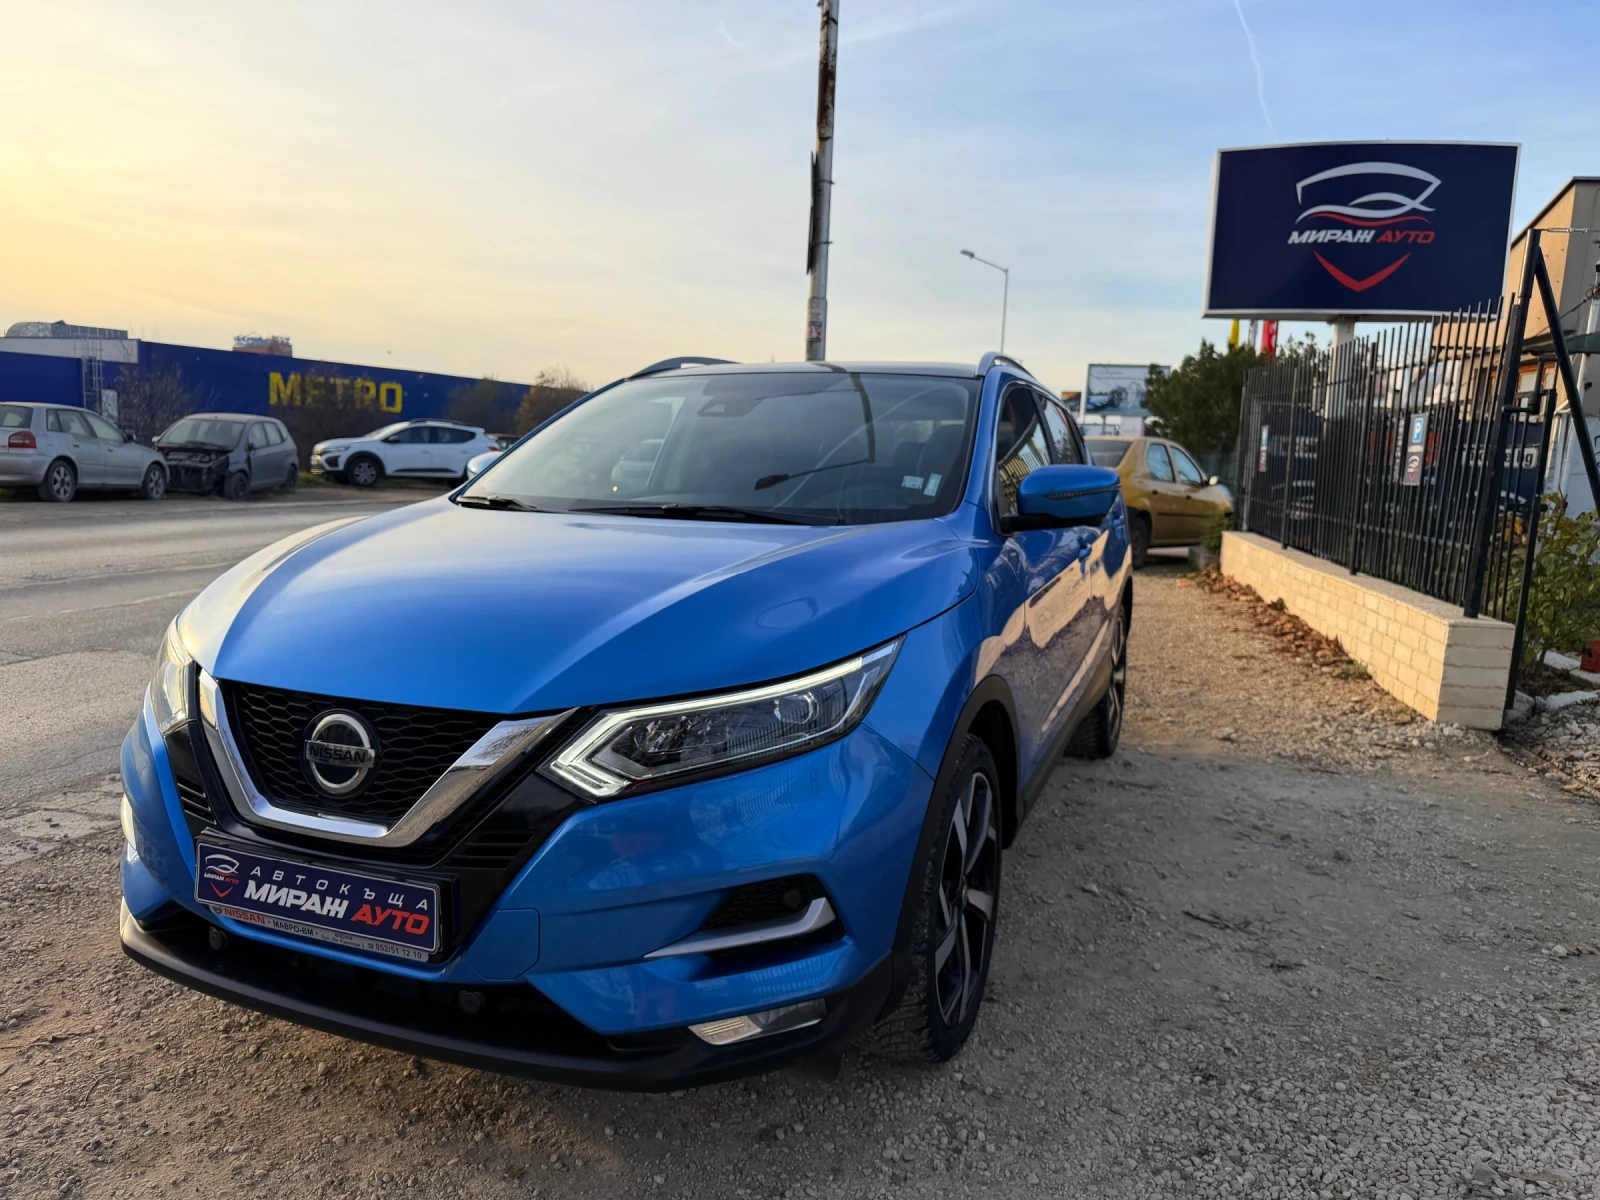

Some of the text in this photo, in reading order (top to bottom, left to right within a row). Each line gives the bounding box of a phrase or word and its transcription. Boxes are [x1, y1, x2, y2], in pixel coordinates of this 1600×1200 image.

[1287, 229, 1435, 245] МИРАЖ АУТО
[268, 371, 403, 413] METRO
[309, 745, 366, 763] NISSAN
[203, 872, 225, 882] МИРАЖ
[250, 866, 428, 911] АВТОКЪЩА
[225, 907, 265, 925] NISSAN
[244, 879, 430, 935] МИРАЖ АУТО
[375, 943, 399, 955] 052/51
[402, 949, 411, 957] 12
[413, 950, 422, 959] 10
